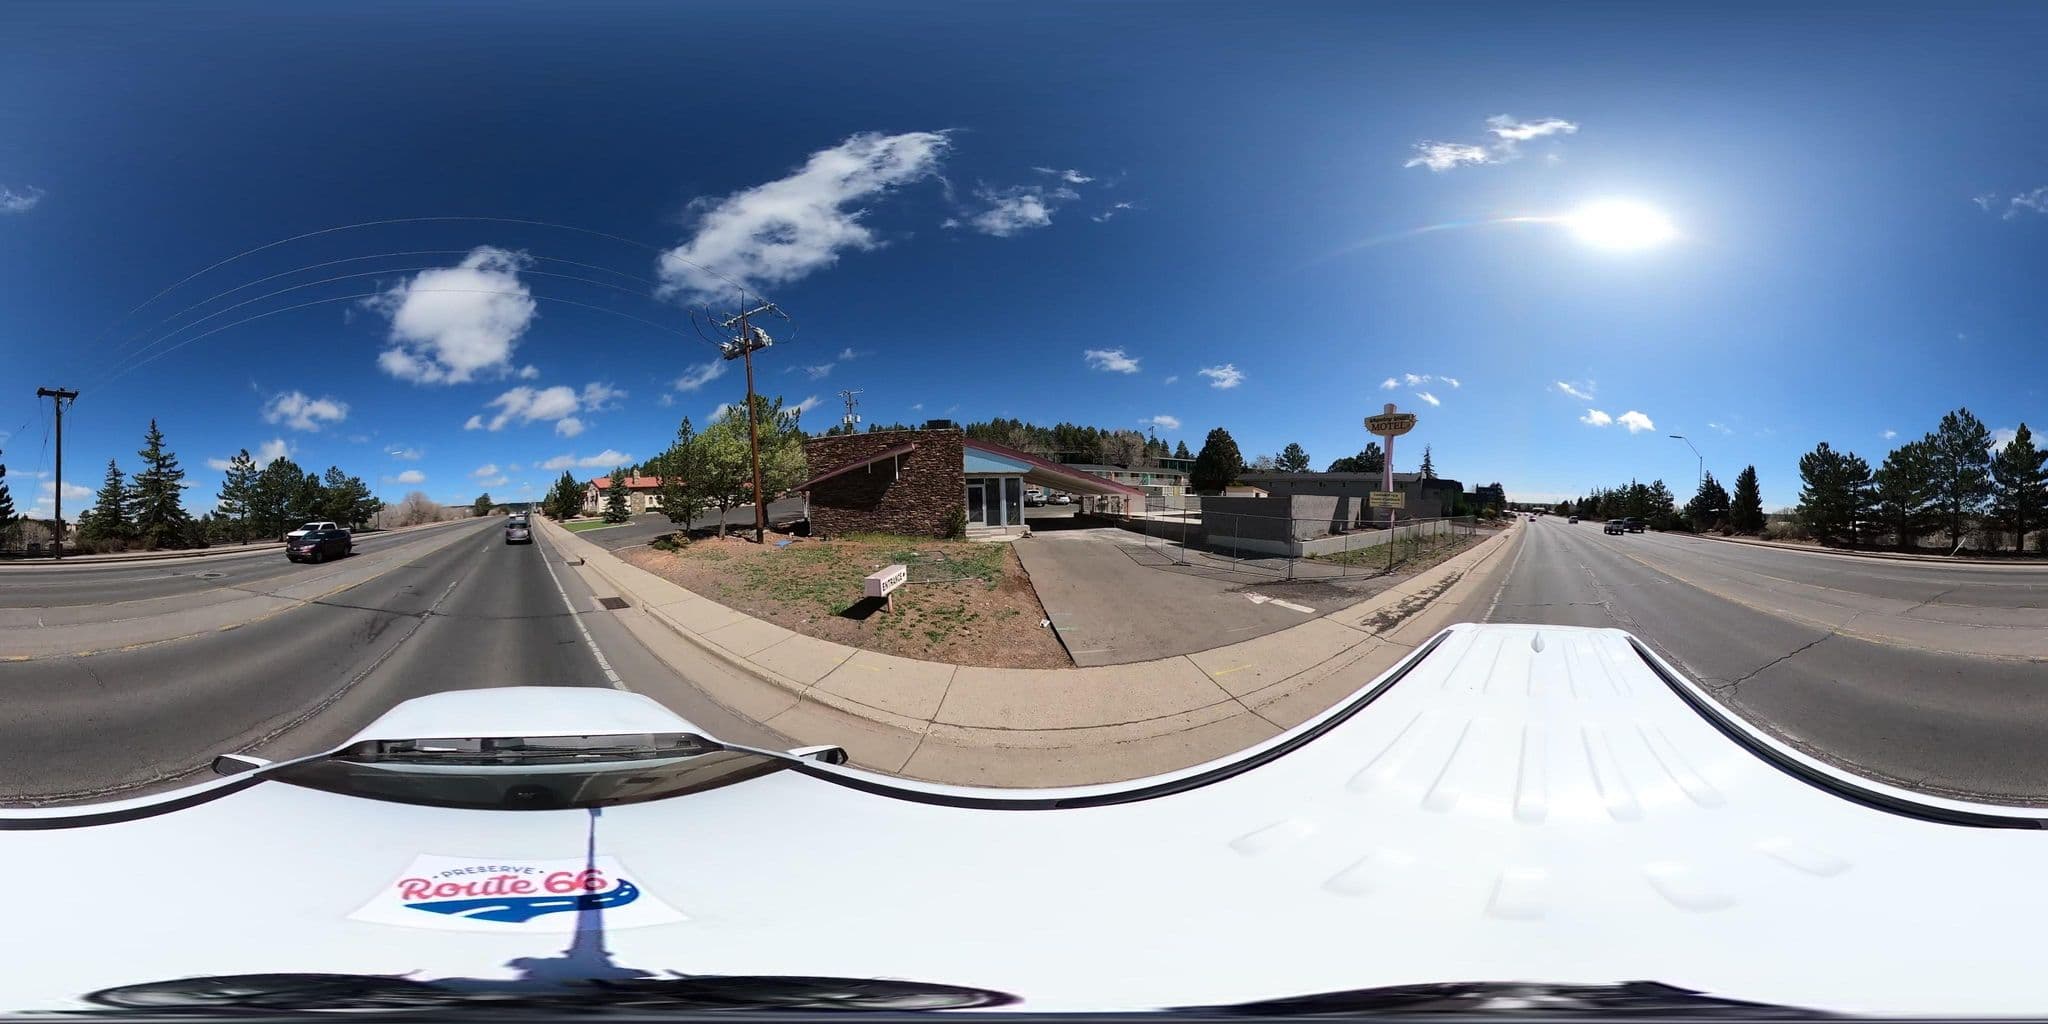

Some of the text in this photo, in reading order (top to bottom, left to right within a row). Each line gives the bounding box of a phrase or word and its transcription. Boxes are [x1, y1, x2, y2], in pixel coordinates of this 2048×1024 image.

[1371, 421, 1406, 431] MOTEL
[882, 572, 902, 592] ENTRANCE
[441, 865, 535, 878] PRESERVE
[398, 869, 608, 901] Route 66
